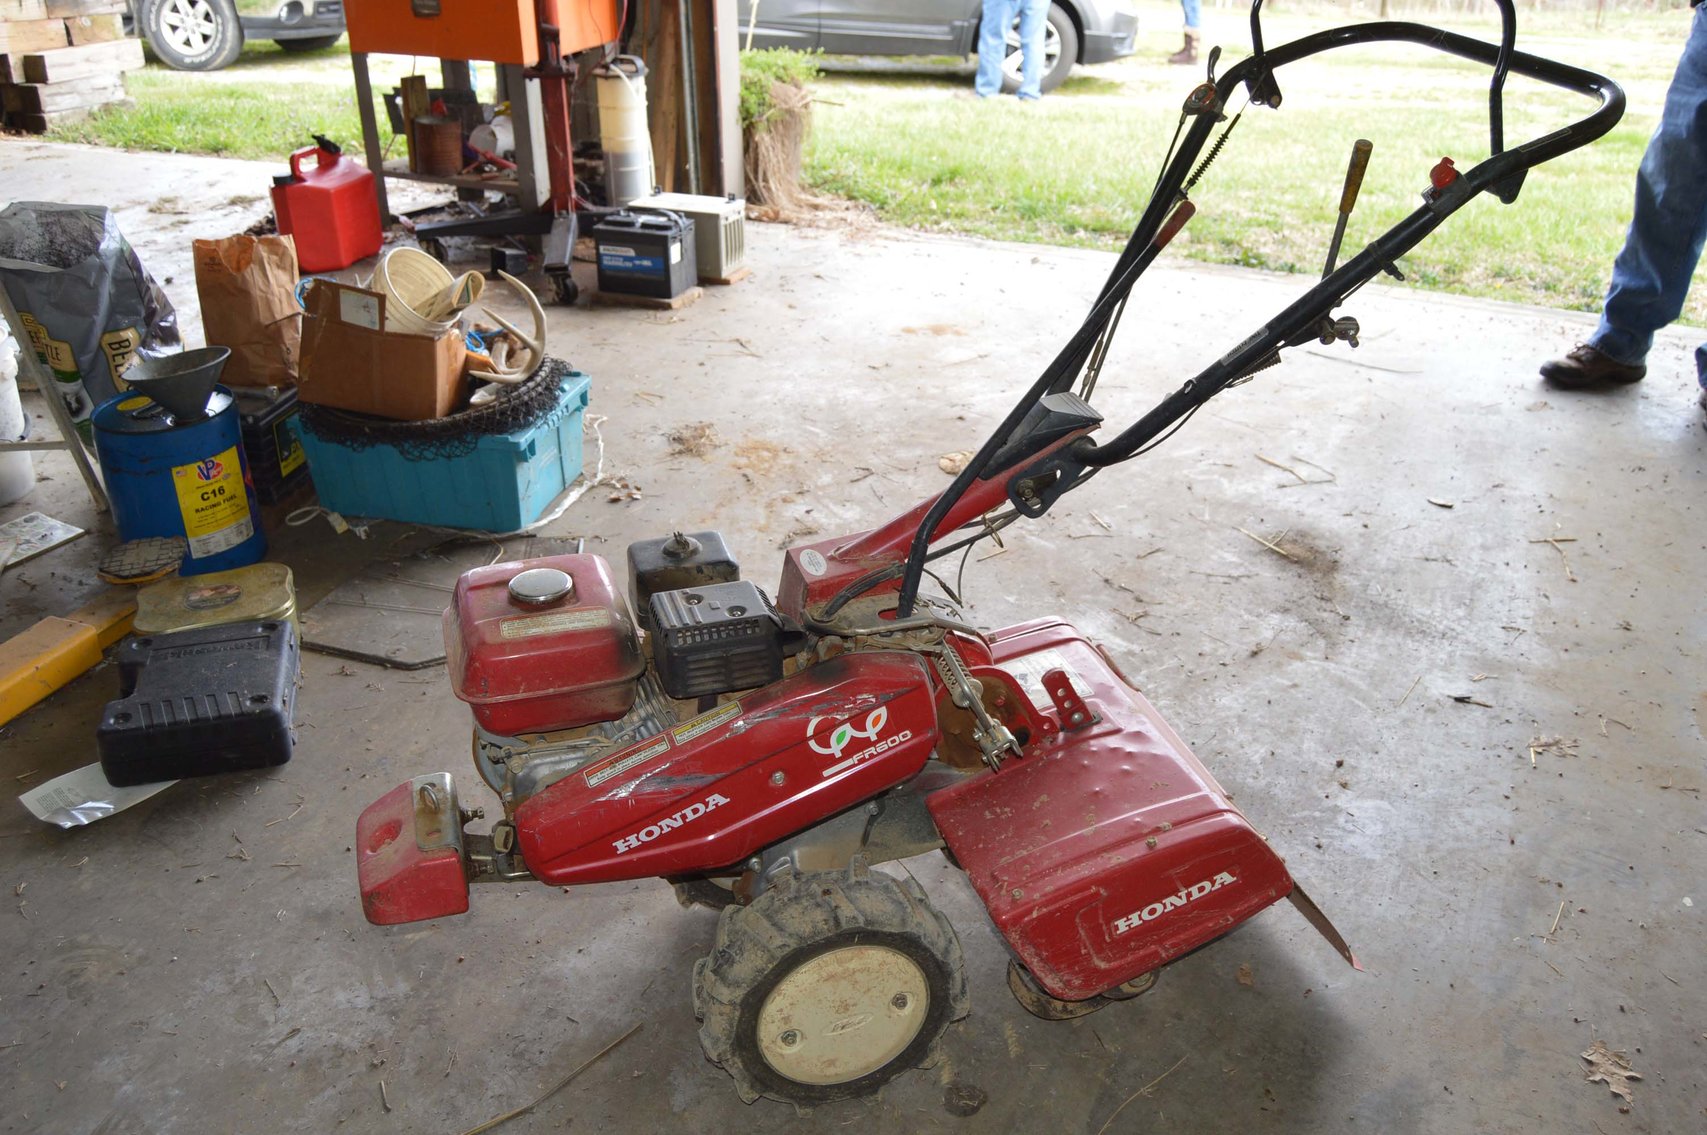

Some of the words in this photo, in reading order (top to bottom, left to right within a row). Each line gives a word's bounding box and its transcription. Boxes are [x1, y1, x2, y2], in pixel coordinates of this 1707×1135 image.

[197, 459, 215, 481] VP
[195, 500, 222, 514] RACING
[222, 494, 238, 505] FUEL
[200, 485, 226, 502] C16
[853, 730, 912, 764] FR600
[612, 793, 730, 854] HONDA
[1114, 871, 1236, 934] HONDA
